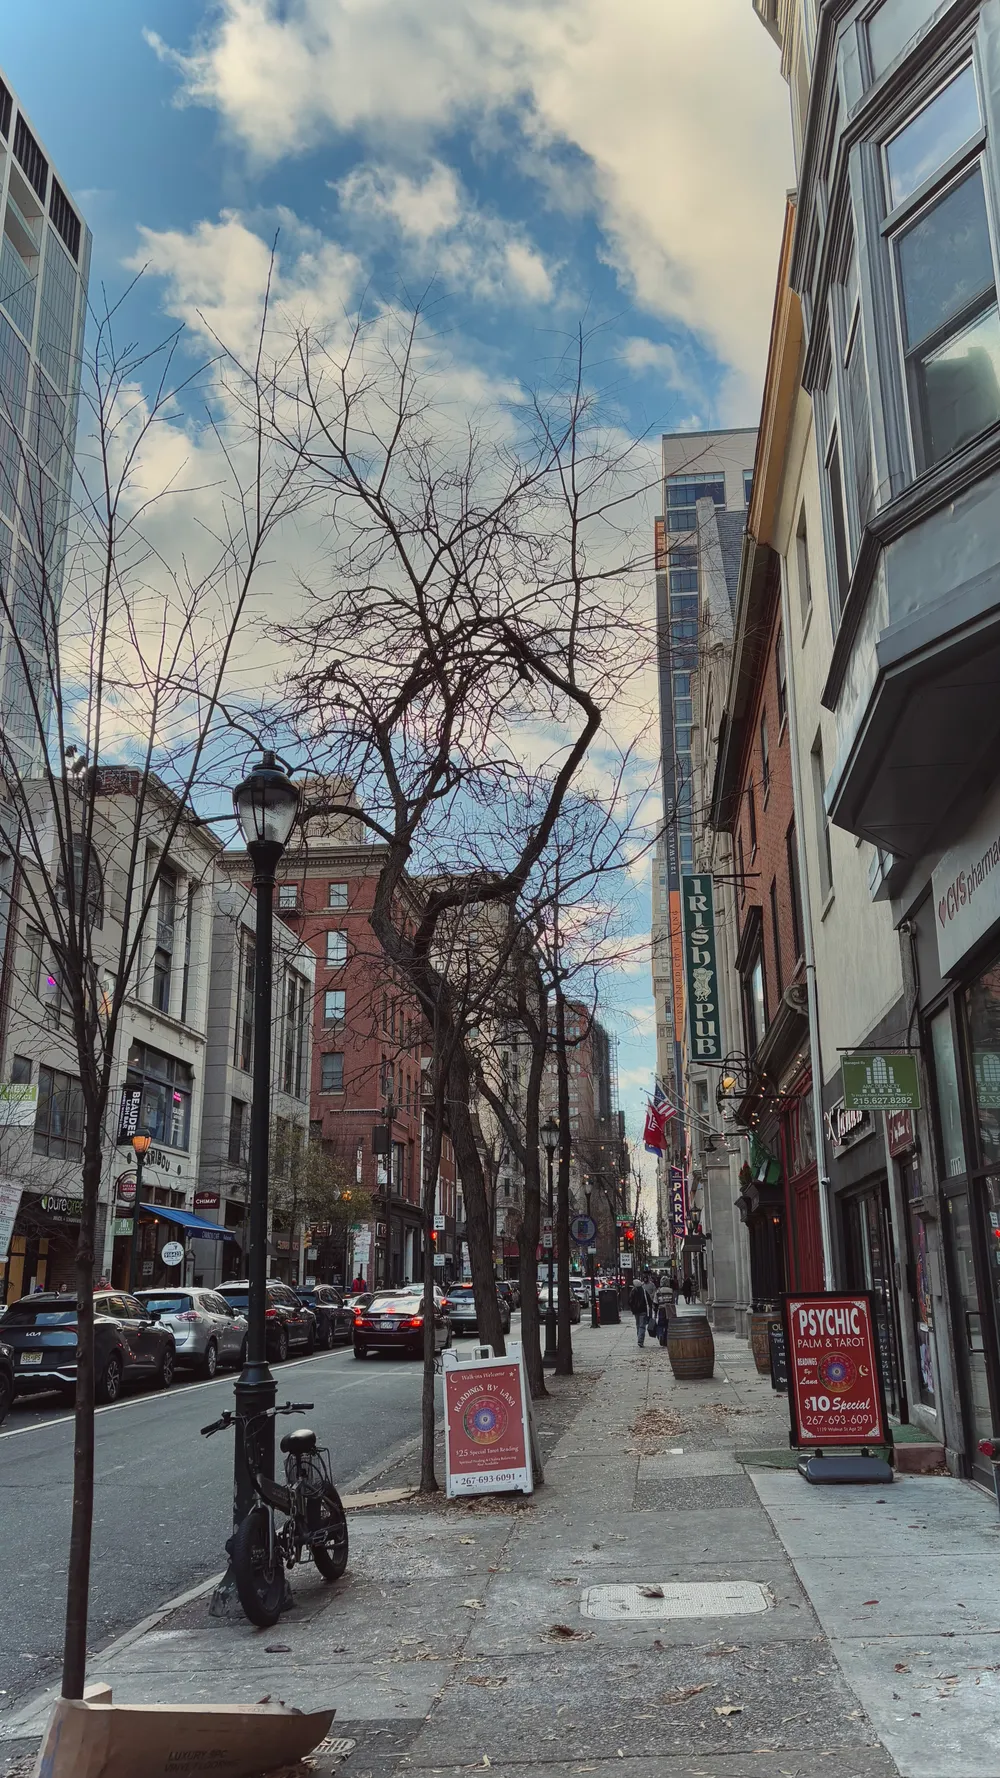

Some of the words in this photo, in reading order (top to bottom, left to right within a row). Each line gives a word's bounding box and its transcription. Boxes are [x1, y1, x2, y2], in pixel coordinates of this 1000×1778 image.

[668, 798, 676, 875] 1213WALNUCOM
[947, 871, 966, 920] CVS
[967, 836, 1000, 904] pharma
[127, 1091, 141, 1136] BEAUDEE
[142, 1150, 170, 1172] ARIBOU
[47, 1197, 83, 1215] puregree
[674, 1182, 683, 1223] PARK
[799, 1308, 860, 1336] PSYCHIC
[797, 1339, 823, 1348] PALM
[825, 1338, 833, 1348] &
[834, 1337, 865, 1348] TAROT
[797, 1357, 818, 1366] READINGS
[799, 1376, 818, 1385] Lana
[453, 1384, 484, 1413] READINGS
[499, 1389, 516, 1407] LANA
[804, 1395, 830, 1411] $10
[832, 1397, 870, 1413] Special
[806, 1414, 873, 1425] 267-693-6091
[456, 1448, 469, 1457] $25
[461, 1473, 515, 1485] 267-693-6091
[168, 1750, 208, 1760] LUXURY
[164, 1762, 190, 1773] VINYL
